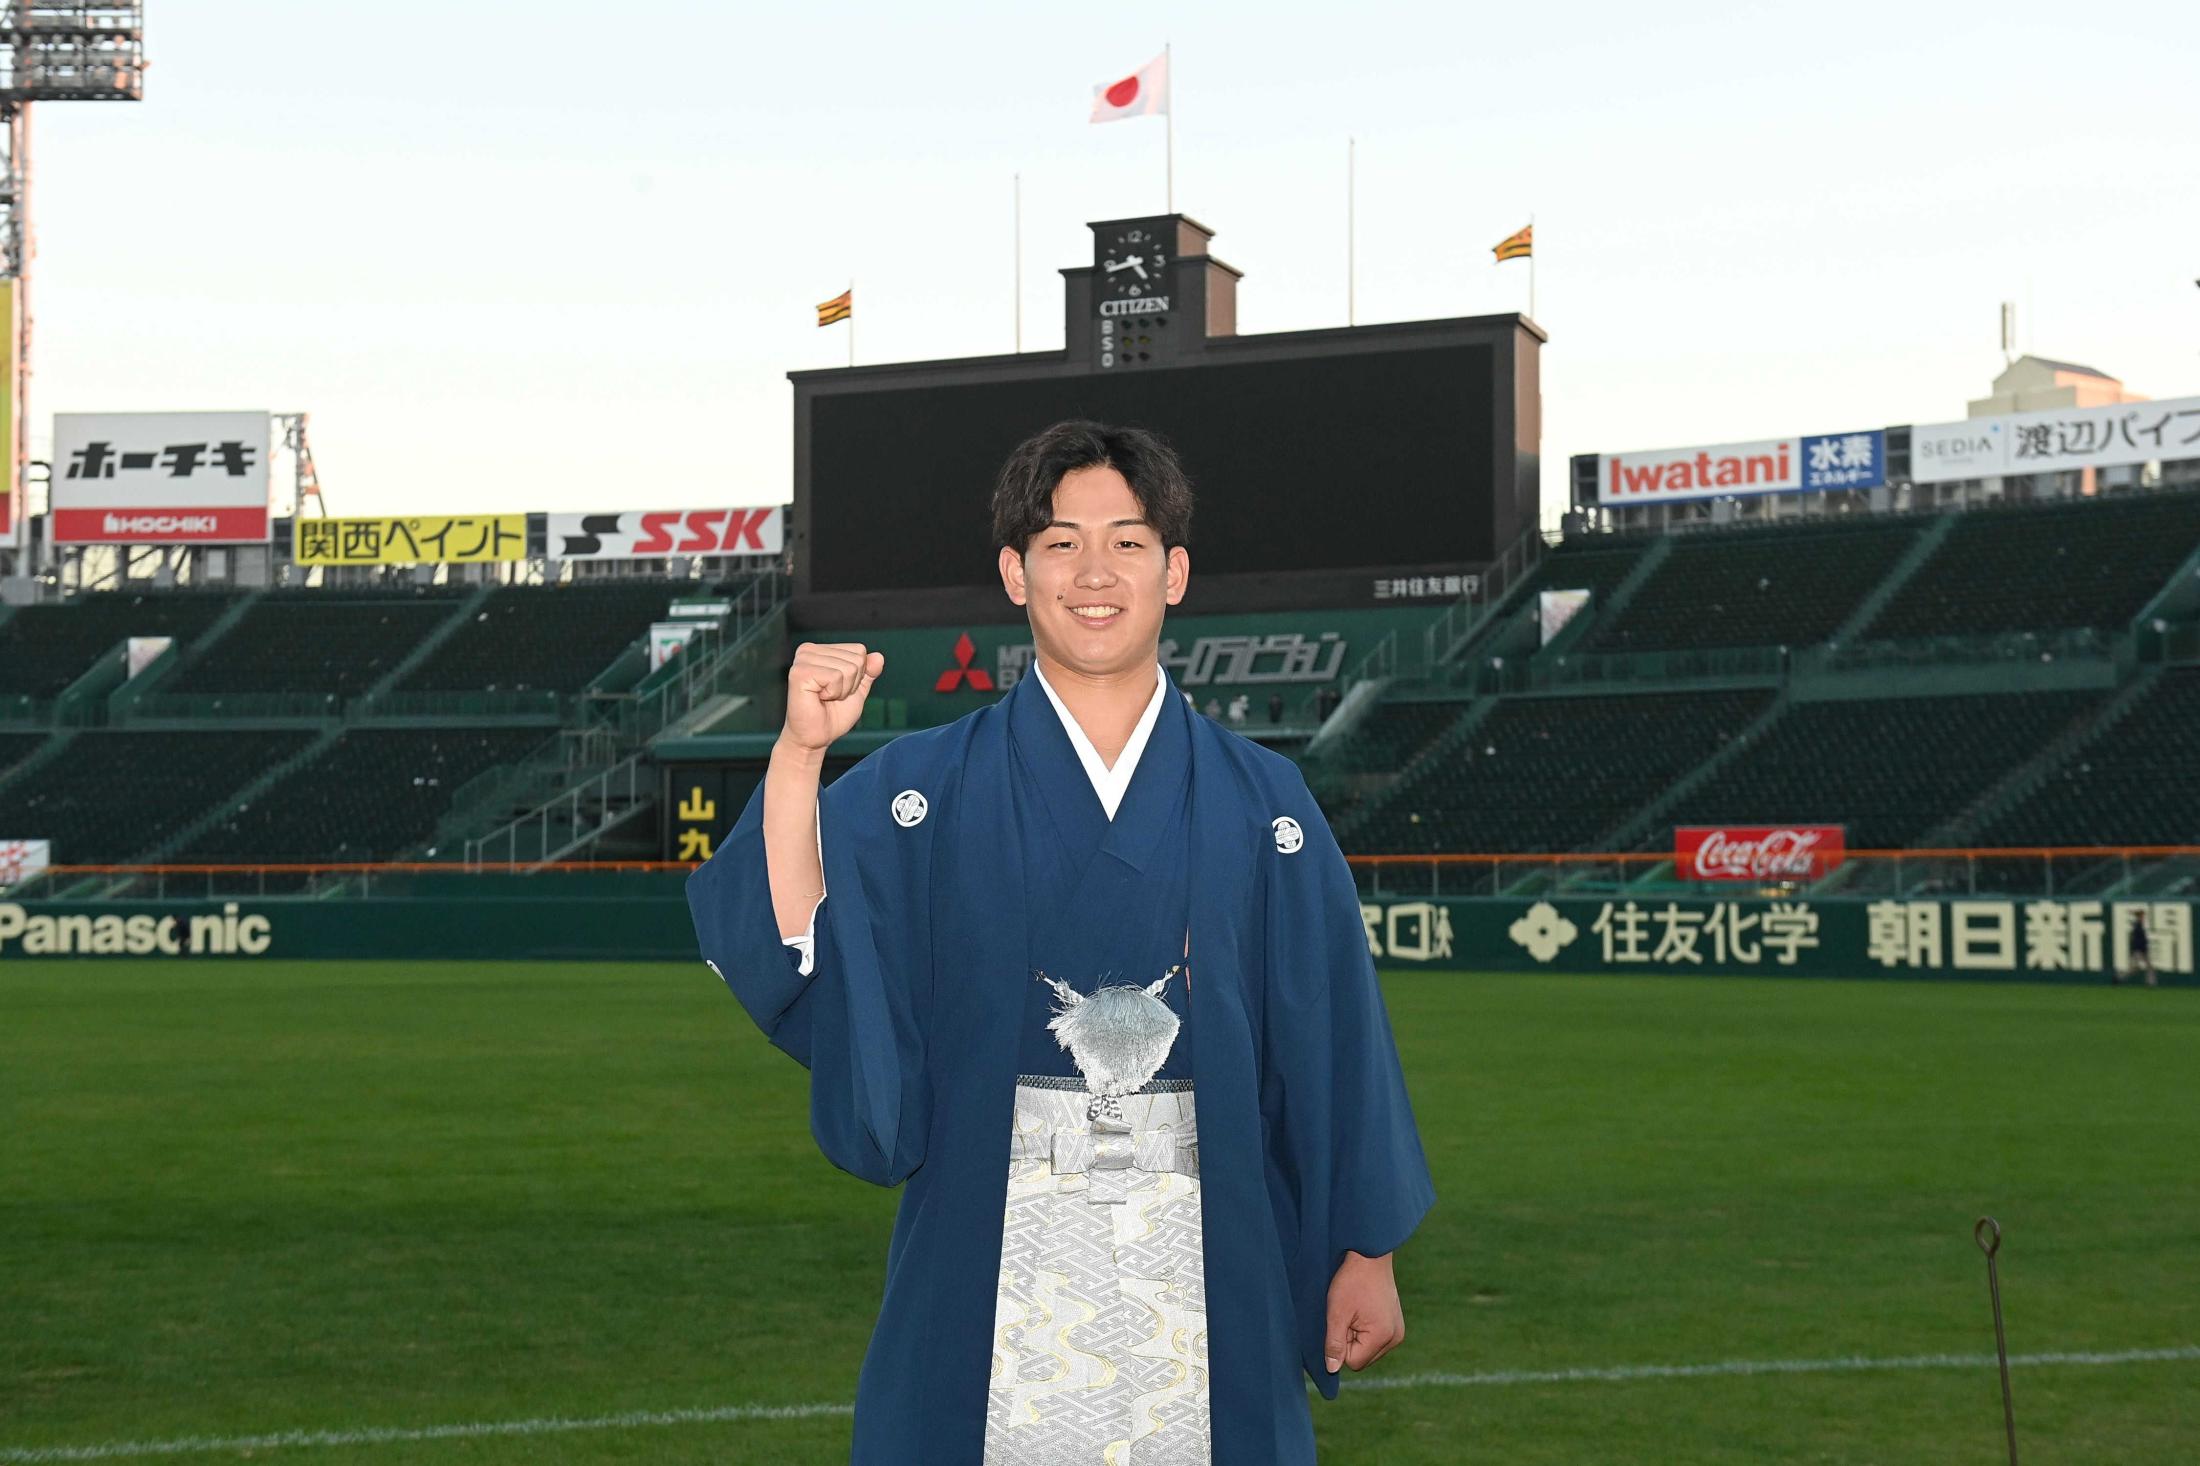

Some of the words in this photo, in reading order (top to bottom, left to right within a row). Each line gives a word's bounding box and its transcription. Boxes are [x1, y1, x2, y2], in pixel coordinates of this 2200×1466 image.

[1153, 254, 1166, 268] 3
[1100, 296, 1169, 316] CITIZEN
[1128, 284, 1142, 297] 6
[66, 441, 257, 479] ホーチキ
[1609, 443, 1790, 495] Iwatani
[1808, 435, 1873, 471] 水素
[120, 515, 217, 534] HOCHIKI
[300, 518, 522, 560] 関西ペイント
[631, 508, 774, 554] SSK
[1373, 574, 1479, 599] 三井住友銀行
[679, 786, 715, 860] 山九
[1695, 830, 1822, 877] Coca-Cola
[0, 902, 271, 955] Panasonic
[1591, 901, 1820, 965] 住友化学
[1866, 900, 2194, 974] 朝日新聞
